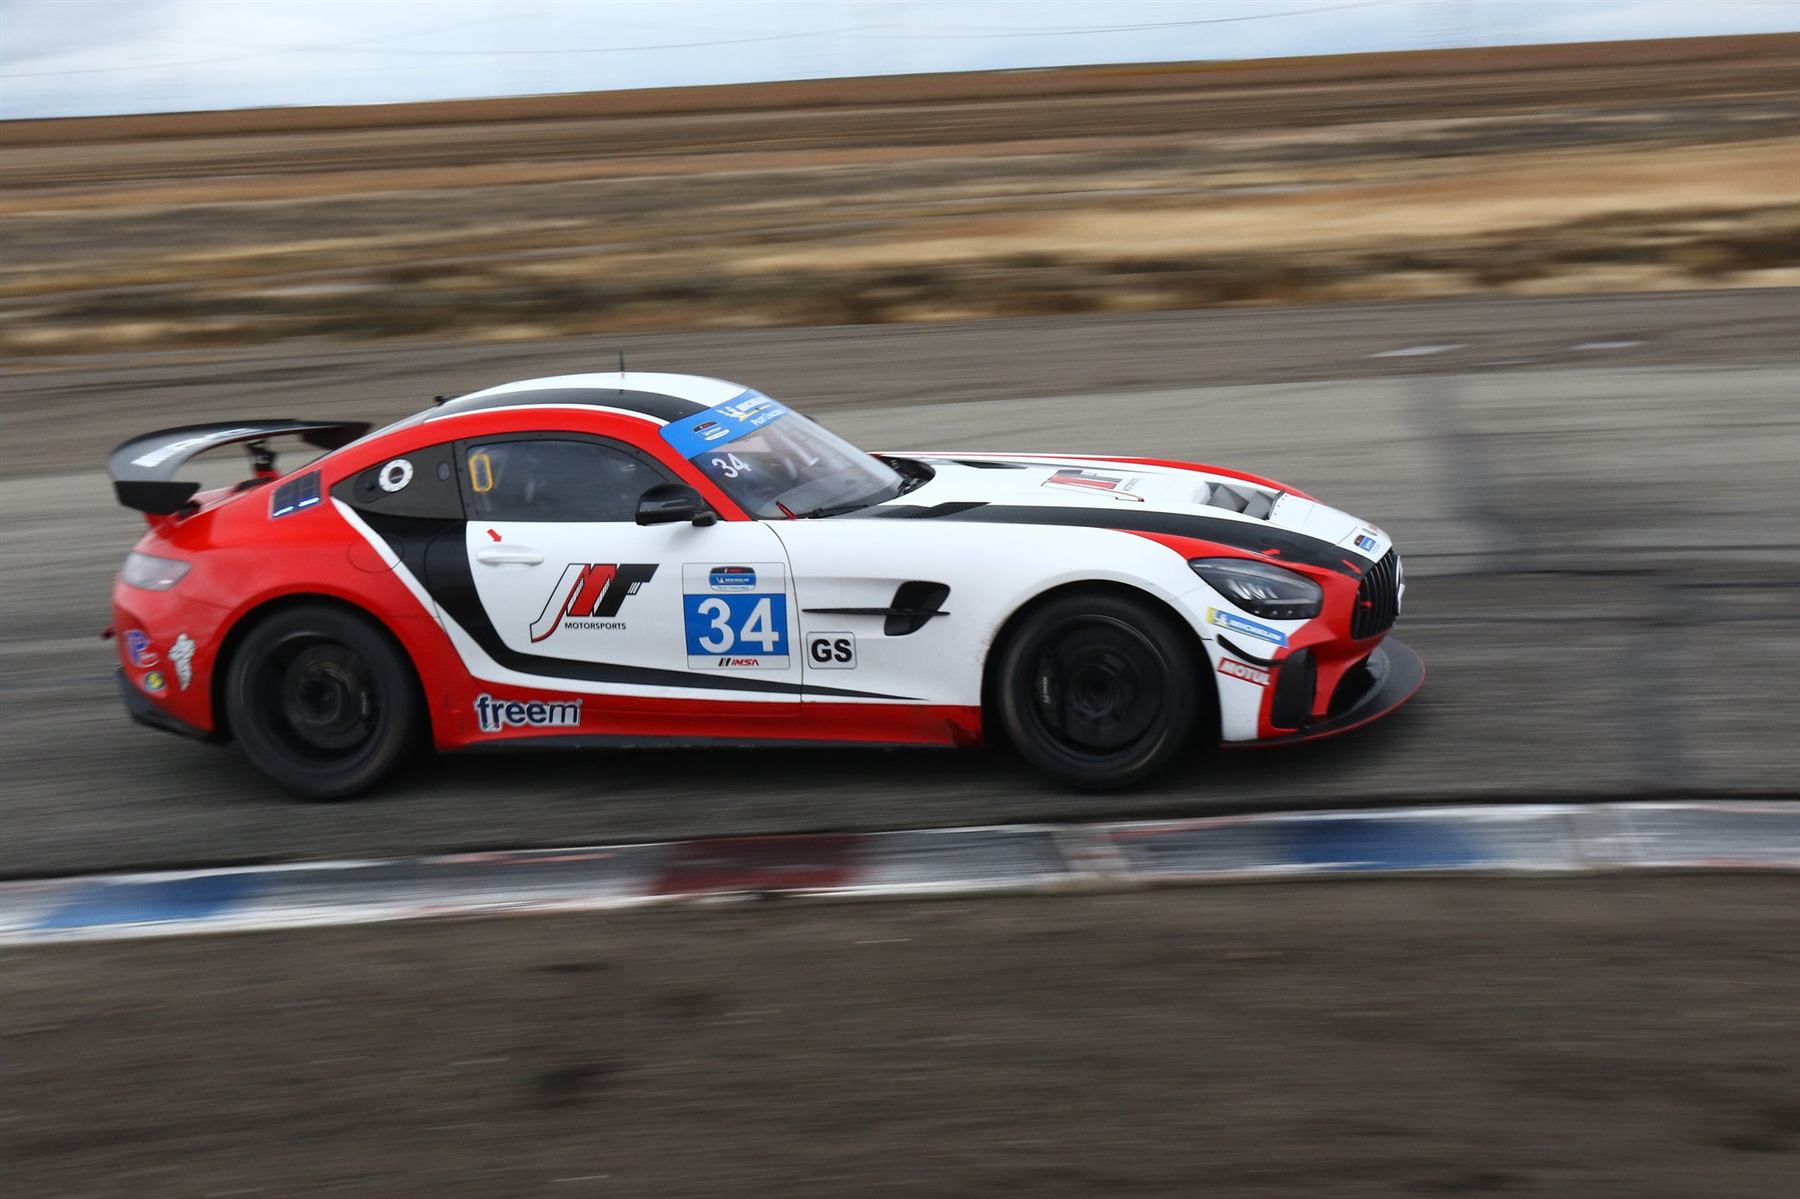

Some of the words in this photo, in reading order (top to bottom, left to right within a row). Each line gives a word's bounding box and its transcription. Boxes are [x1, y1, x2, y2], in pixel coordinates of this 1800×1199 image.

[711, 452, 751, 478] 34
[564, 622, 627, 630] MOTORSPORTS
[697, 598, 780, 654] 34
[731, 658, 759, 666] IMSA
[811, 639, 852, 663] GS
[476, 696, 579, 727] freem
